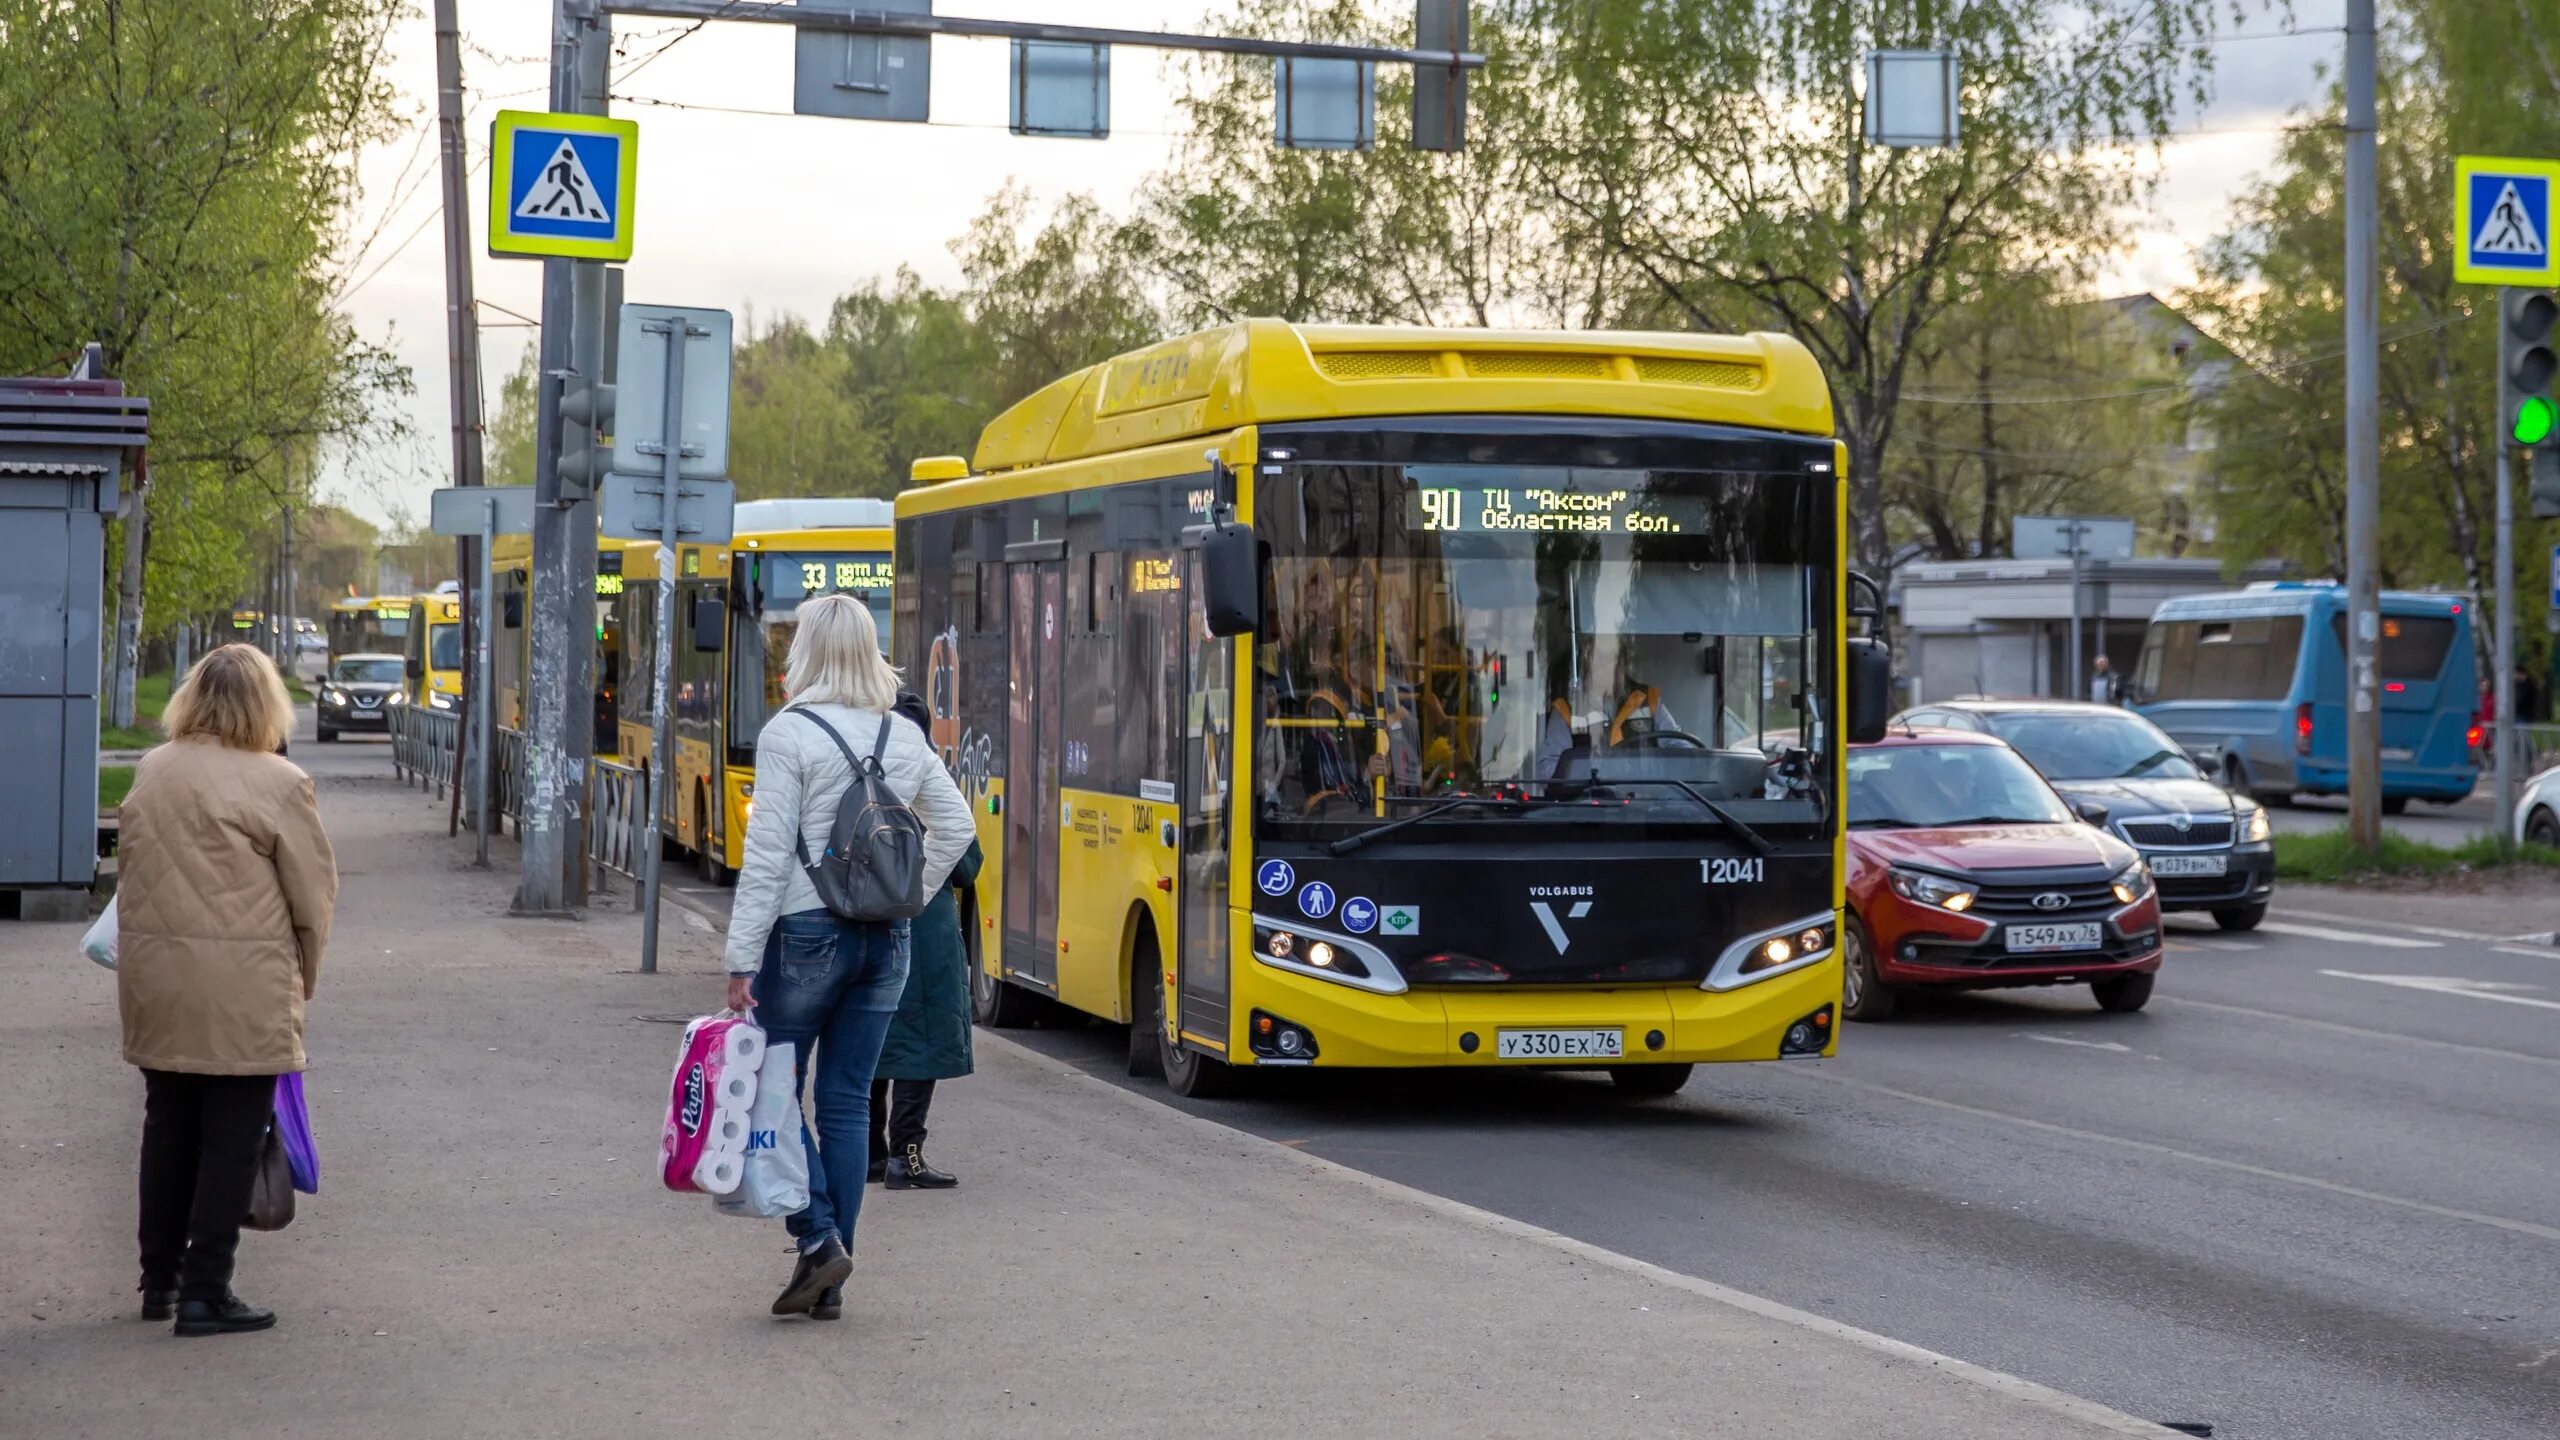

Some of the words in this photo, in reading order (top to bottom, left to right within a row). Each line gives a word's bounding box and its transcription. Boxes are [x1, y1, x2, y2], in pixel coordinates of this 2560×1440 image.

[1421, 488, 1461, 531] 90
[1482, 488, 1511, 514] ТЦ
[1482, 508, 1612, 530] Областная
[1625, 511, 1681, 532] бол.
[802, 563, 826, 589] 33
[1132, 803, 1154, 834] 12041
[1700, 858, 1764, 883] 12041
[1529, 886, 1594, 896] VOLGABUS
[1391, 916, 1407, 925] КПГ
[1596, 1032, 1616, 1049] 76
[682, 1066, 703, 1132] Papia
